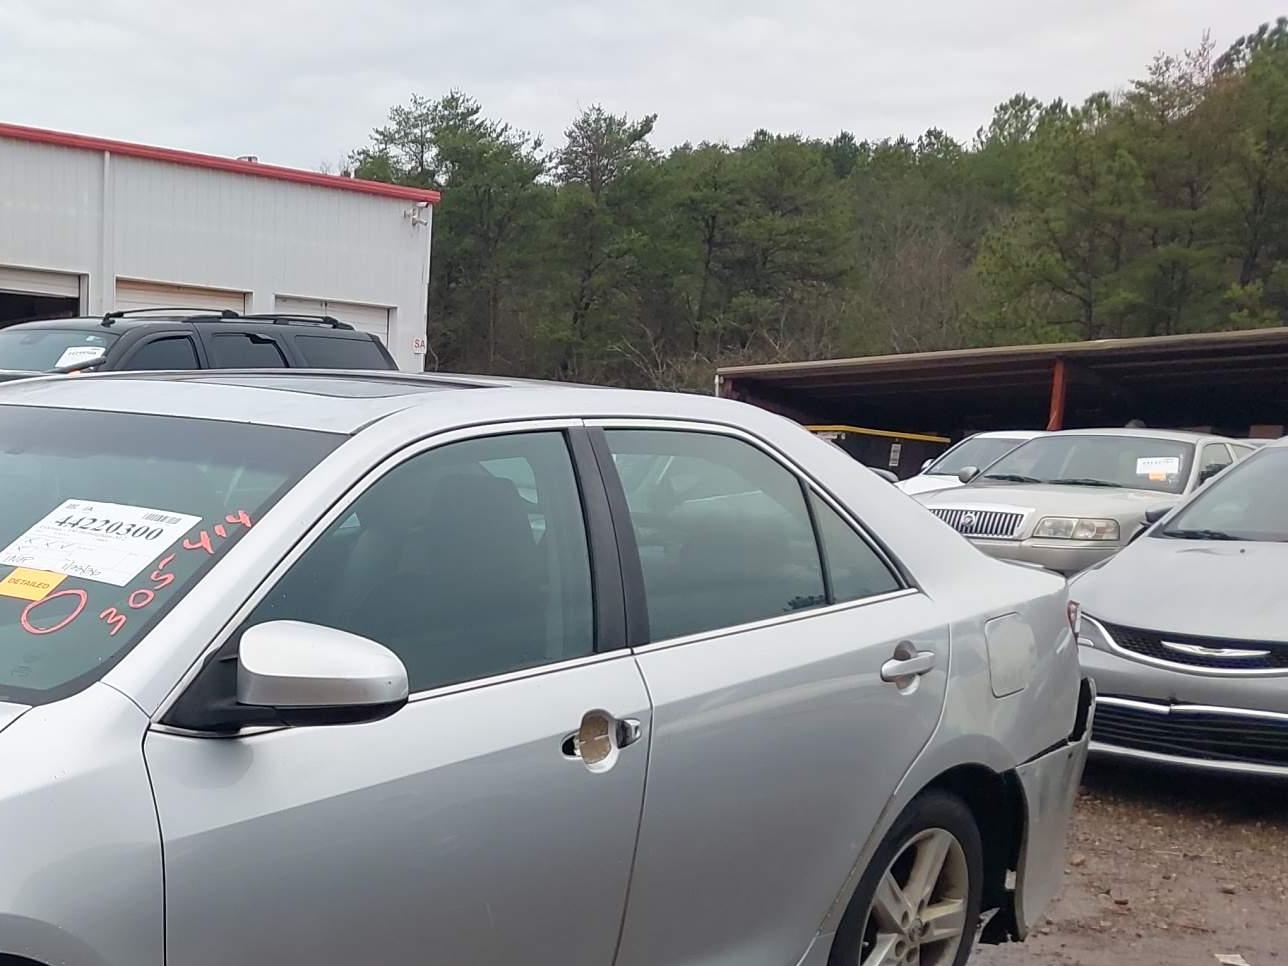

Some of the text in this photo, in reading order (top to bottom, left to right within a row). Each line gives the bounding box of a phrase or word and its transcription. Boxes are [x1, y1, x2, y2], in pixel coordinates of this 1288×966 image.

[414, 338, 425, 349] SA
[55, 513, 164, 541] 44220300
[7, 577, 50, 590] DETAILED
